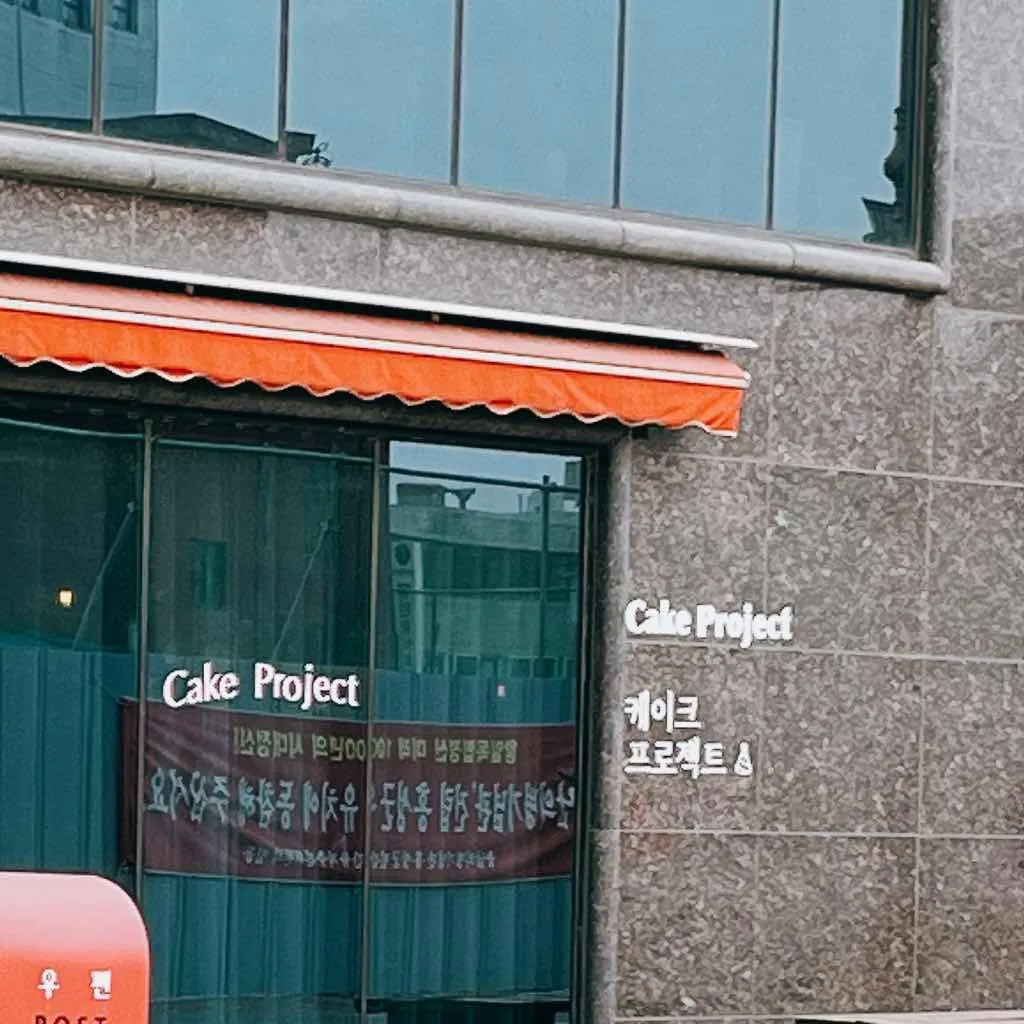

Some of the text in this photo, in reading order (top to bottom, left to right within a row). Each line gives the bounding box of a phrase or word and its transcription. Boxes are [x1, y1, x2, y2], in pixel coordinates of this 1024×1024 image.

[626, 599, 793, 648] Cake Project
[162, 660, 360, 710] Cake Project
[624, 689, 704, 733] 케이크
[624, 736, 727, 779] 프로젝트
